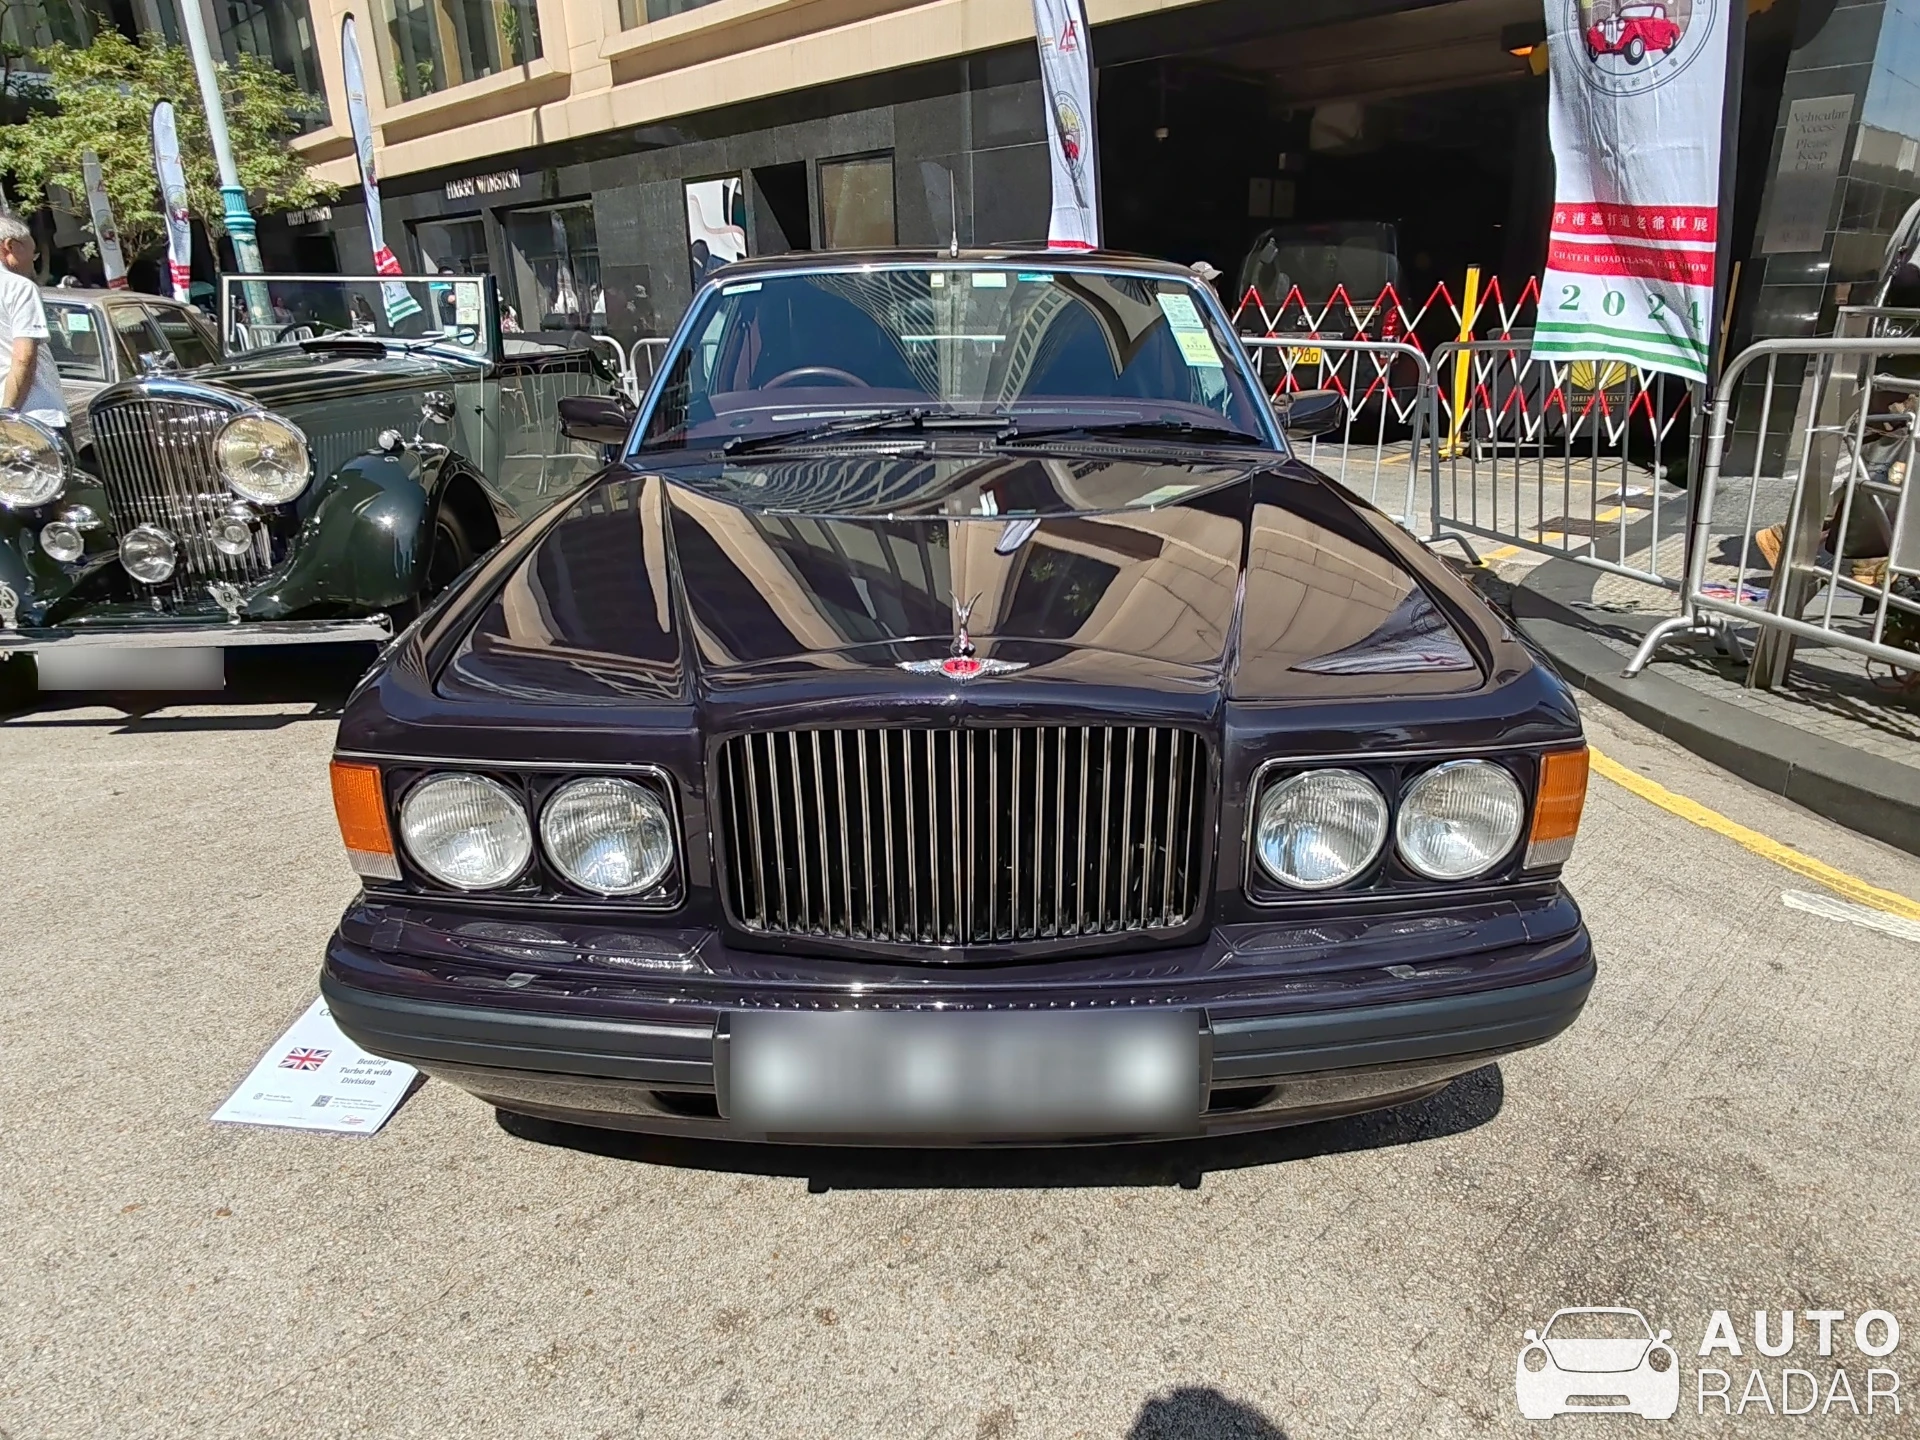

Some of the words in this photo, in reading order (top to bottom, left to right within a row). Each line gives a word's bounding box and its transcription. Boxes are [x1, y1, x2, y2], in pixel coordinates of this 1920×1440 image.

[1794, 109, 1849, 123] Vehicular
[1798, 124, 1837, 134] Access
[1796, 138, 1831, 149] Please
[1797, 150, 1827, 162] Keep
[445, 177, 475, 200] HARRY
[475, 168, 521, 194] WINSTON
[1554, 251, 1590, 263] CHATER
[1593, 254, 1621, 264] ROAD
[1657, 260, 1676, 271] CAR
[1680, 261, 1709, 273] SHOW
[1559, 284, 1705, 331] 2024
[222, 591, 234, 602] B
[356, 1058, 389, 1067] Bentley
[339, 1066, 365, 1075] Turbo
[340, 1077, 376, 1086] Division
